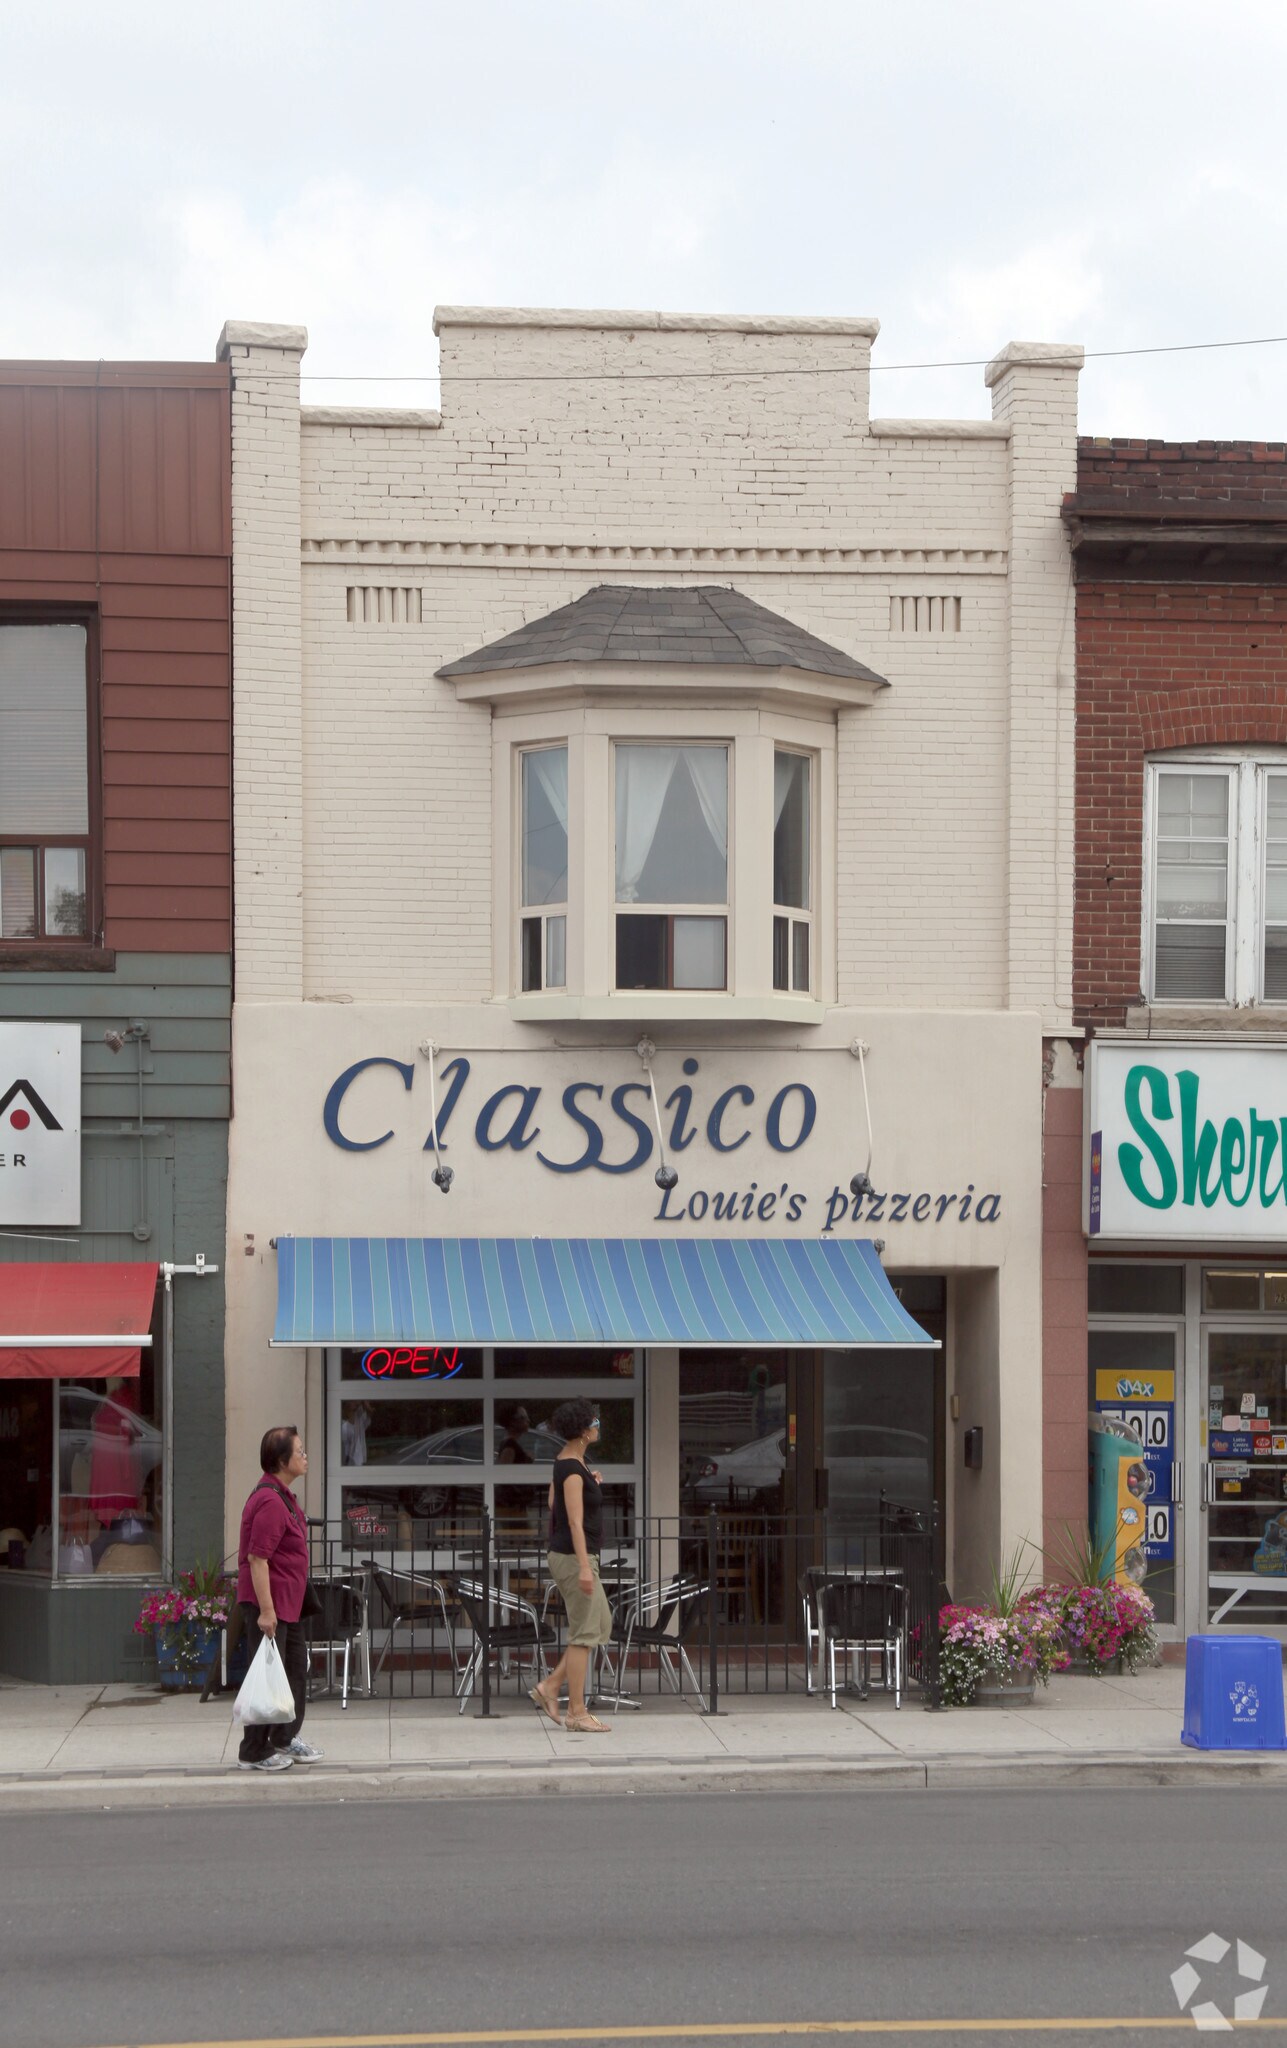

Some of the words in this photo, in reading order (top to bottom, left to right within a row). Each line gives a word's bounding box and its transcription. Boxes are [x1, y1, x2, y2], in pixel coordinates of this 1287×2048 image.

[322, 1057, 817, 1174] Classico
[654, 1183, 807, 1222] Louie's
[821, 1184, 1001, 1231] pizzeria
[367, 1347, 459, 1375] OPEN
[1117, 1380, 1152, 1397] MAX
